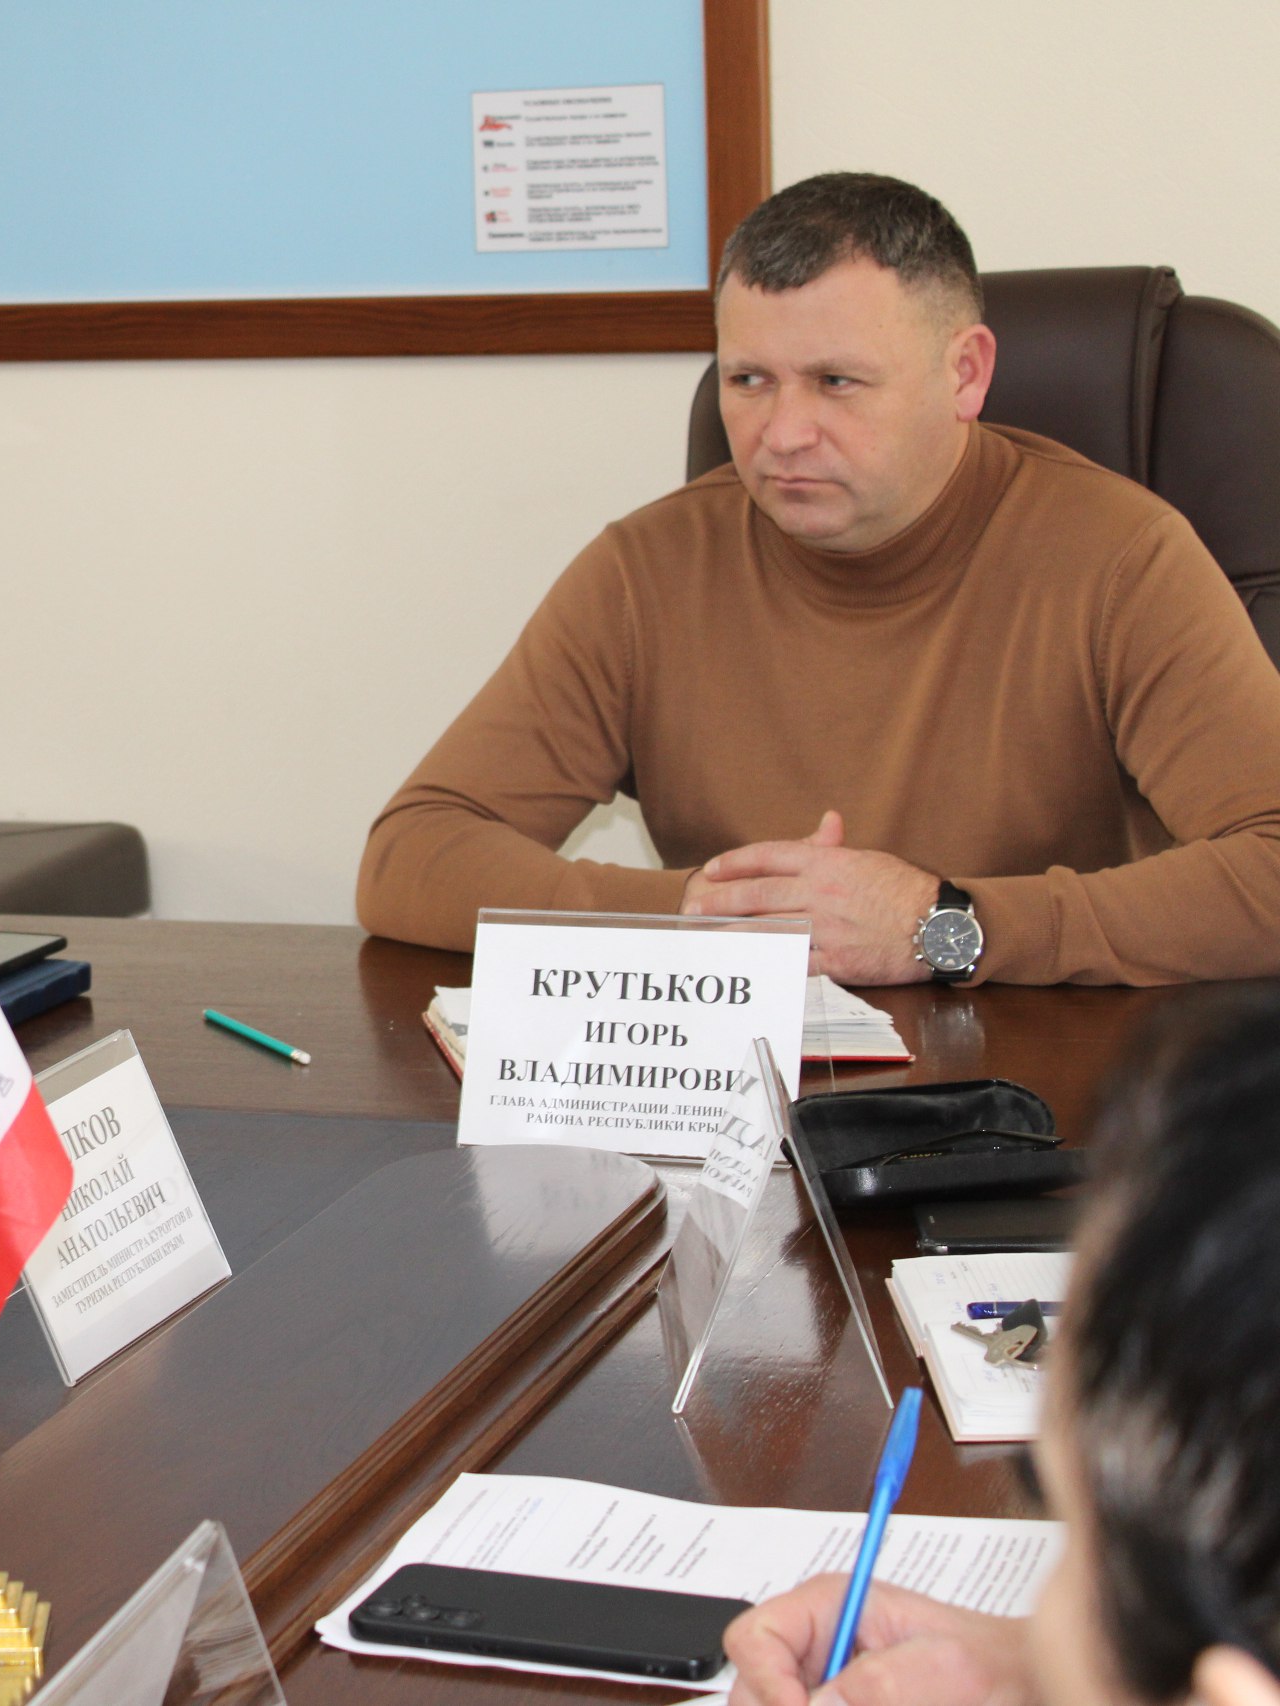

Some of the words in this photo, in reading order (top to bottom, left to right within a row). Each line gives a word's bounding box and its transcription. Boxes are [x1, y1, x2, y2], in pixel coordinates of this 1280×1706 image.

[530, 967, 752, 1005] КРУТЬКОВ
[584, 1020, 689, 1047] ИГОРЬ
[498, 1058, 745, 1092] ВЛАДИМИРОВИ
[489, 1094, 535, 1108] ГЛАВА
[539, 1097, 669, 1116] АДМИНИСТРАЦИИ
[671, 1103, 728, 1118] ЛЕНИН
[525, 1110, 584, 1126] РАЙОНА
[587, 1115, 684, 1132] РЕСПУБЛИКИ
[687, 1120, 719, 1134] КРЫ
[61, 1105, 122, 1161] ЛКОВ
[56, 1180, 166, 1269] АНАТОЛЬЕВИЧ
[52, 1263, 109, 1308] ЗАМЕСТИТЕЛЬ
[106, 1237, 149, 1271] МИНИСТРА
[148, 1211, 187, 1244] КУРОРТОВ
[75, 1285, 114, 1314] ТУРИЗМА
[112, 1246, 163, 1290] РЕСПУБЛИКИ
[162, 1234, 185, 1259] КРЫМ
